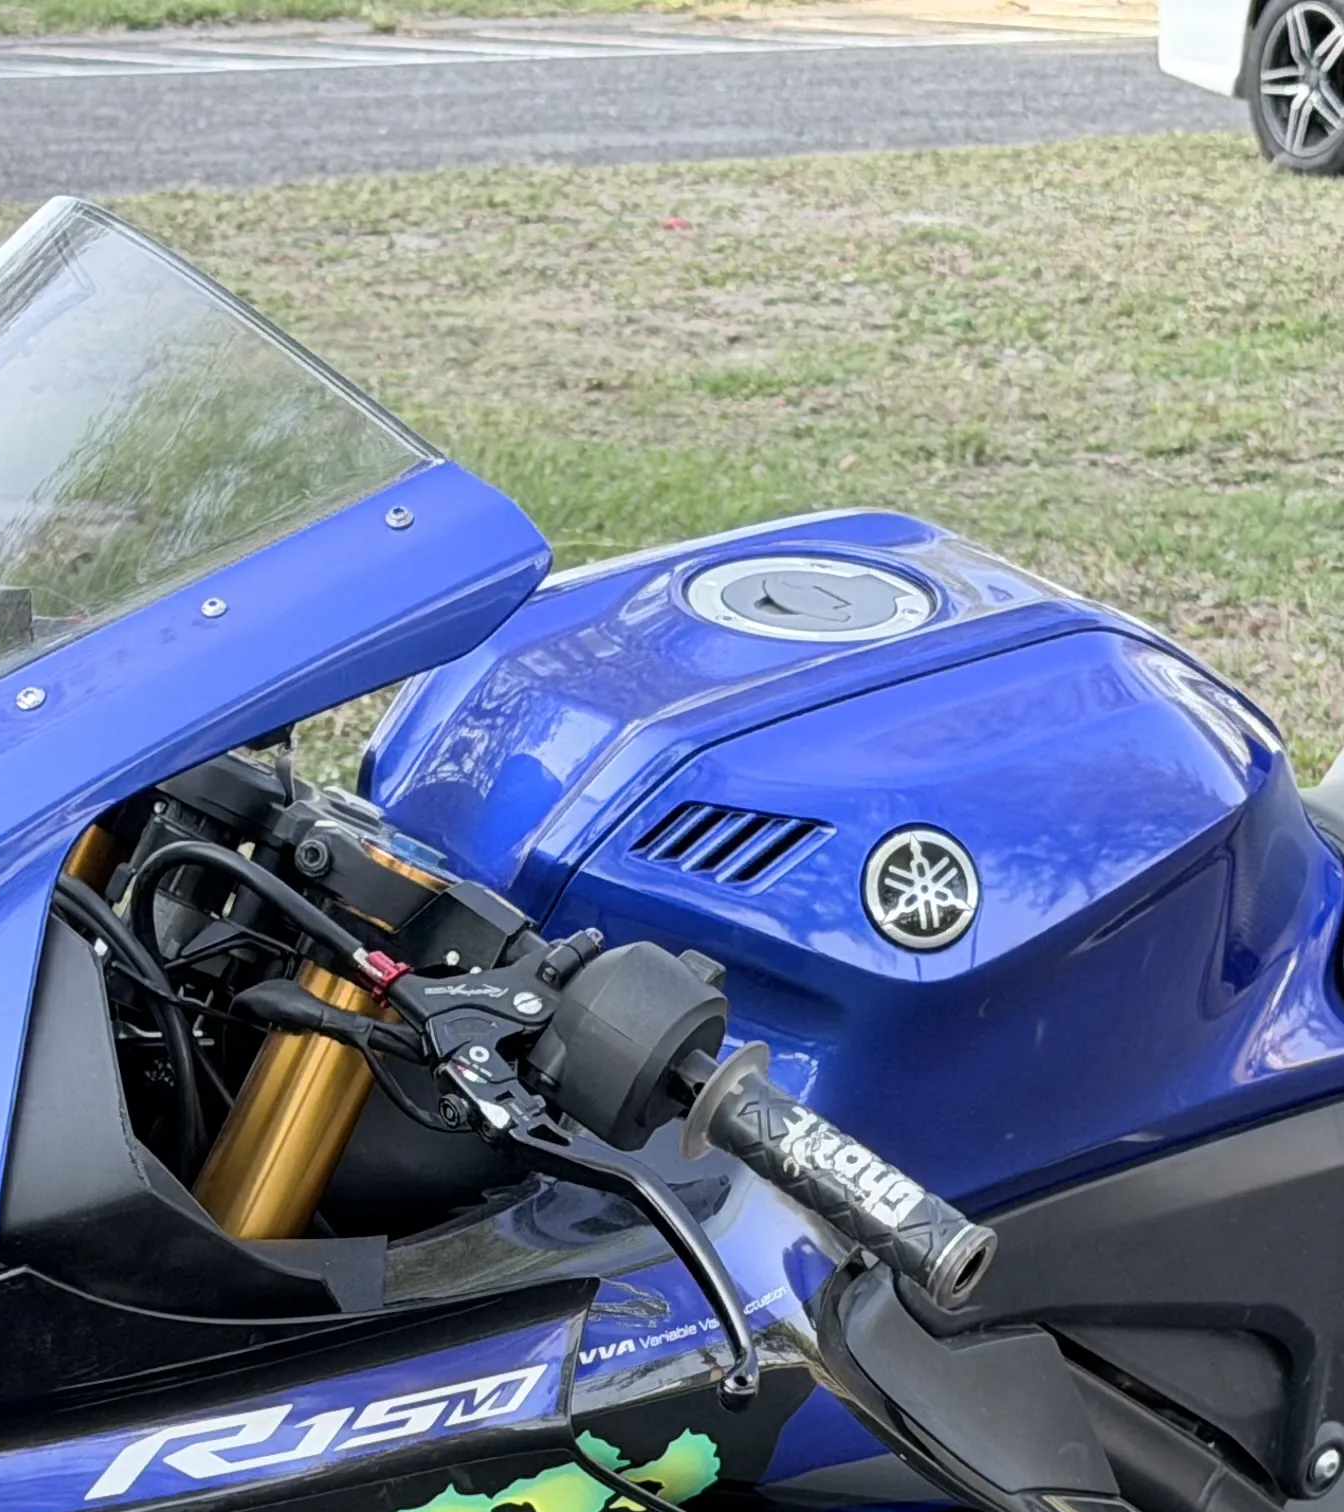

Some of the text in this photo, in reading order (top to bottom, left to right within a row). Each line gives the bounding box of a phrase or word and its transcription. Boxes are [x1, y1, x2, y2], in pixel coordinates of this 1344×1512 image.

[579, 1338, 636, 1366] VVA
[638, 1322, 698, 1350] Variable
[83, 1363, 548, 1501] R15M
